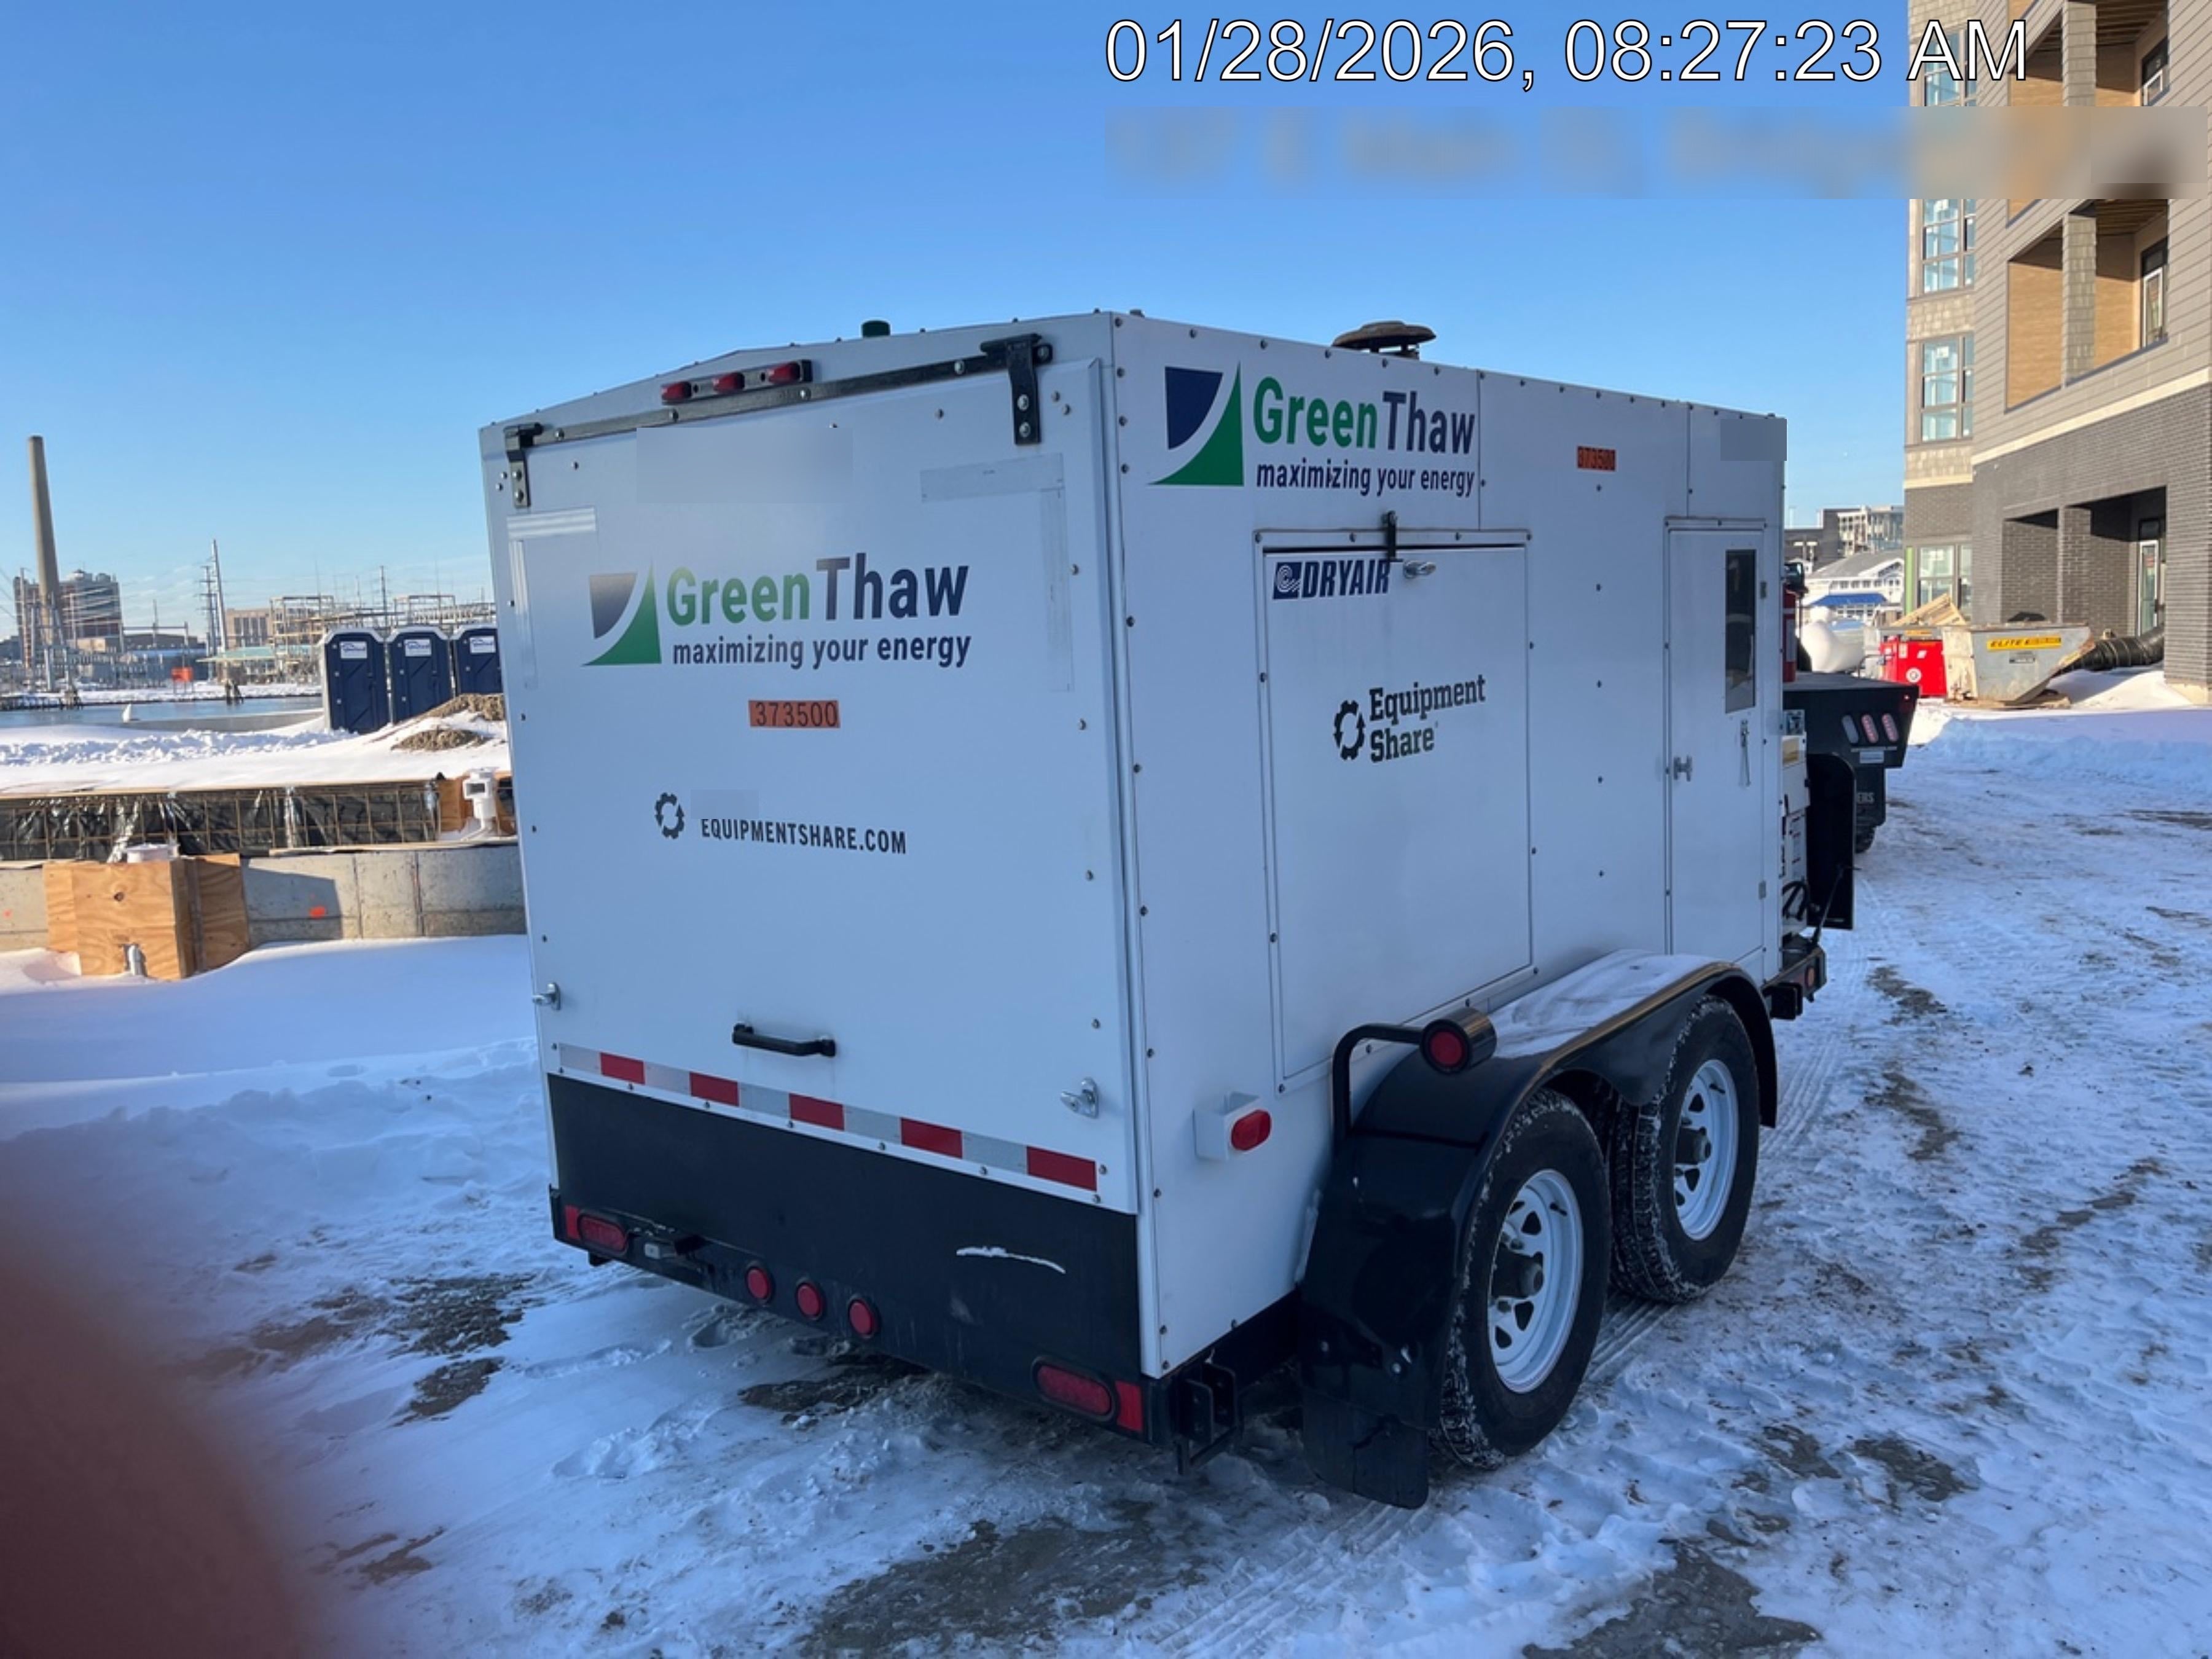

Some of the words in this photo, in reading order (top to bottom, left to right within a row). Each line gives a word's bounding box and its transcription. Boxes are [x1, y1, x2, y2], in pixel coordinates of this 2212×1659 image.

[1257, 457, 1371, 496] maximizing
[1376, 468, 1415, 496] your
[1421, 470, 1475, 498] energy
[1301, 559, 1392, 598] DRYAIR
[673, 635, 804, 670] maximizing
[813, 639, 869, 670] your
[877, 636, 971, 668] energy
[755, 702, 838, 727] 373500
[1369, 674, 1486, 726] Equipment
[1370, 728, 1435, 763] Share
[700, 818, 907, 855] EQUIPMENTSHARE.COM
